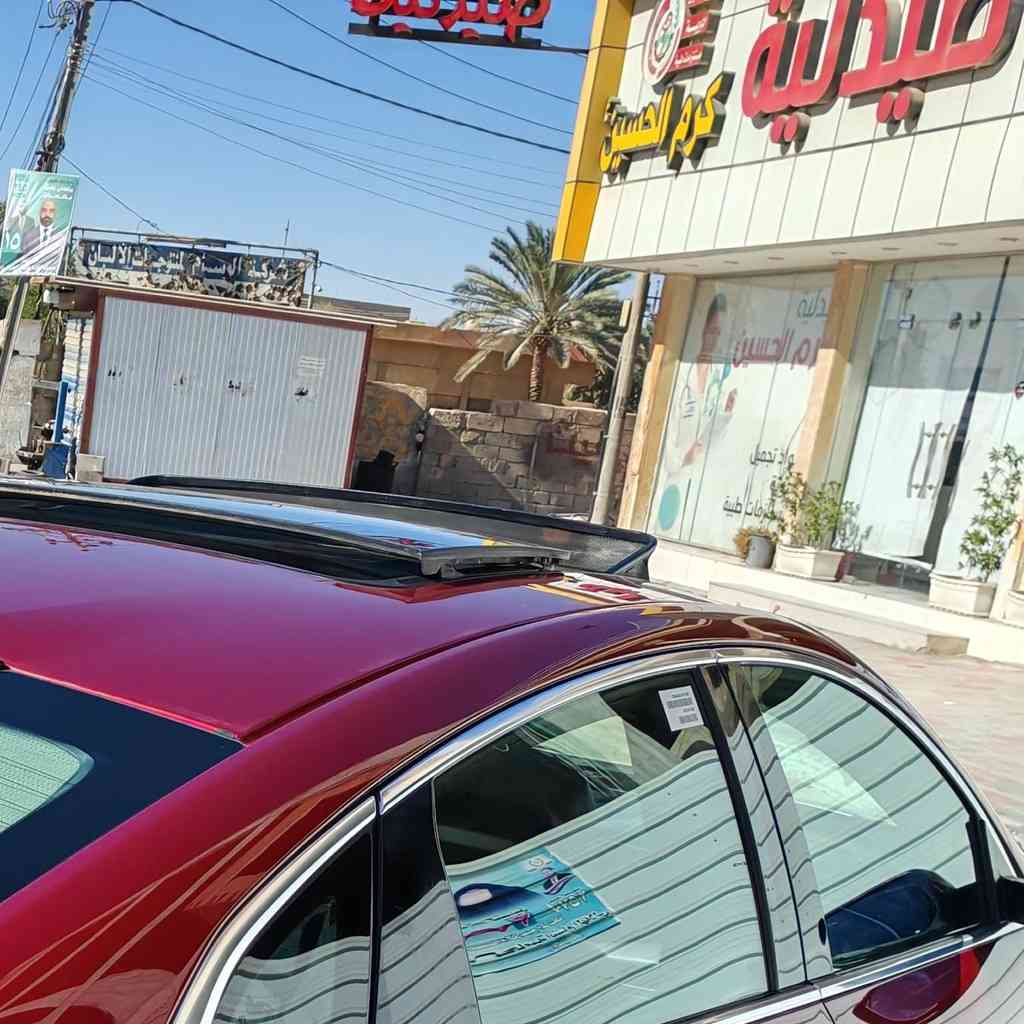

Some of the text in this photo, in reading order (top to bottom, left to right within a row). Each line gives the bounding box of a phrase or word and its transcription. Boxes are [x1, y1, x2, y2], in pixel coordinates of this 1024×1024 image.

[742, 0, 1013, 143] صيدلية
[600, 74, 727, 172] كرم الحسين
[733, 328, 796, 369] الحسين
